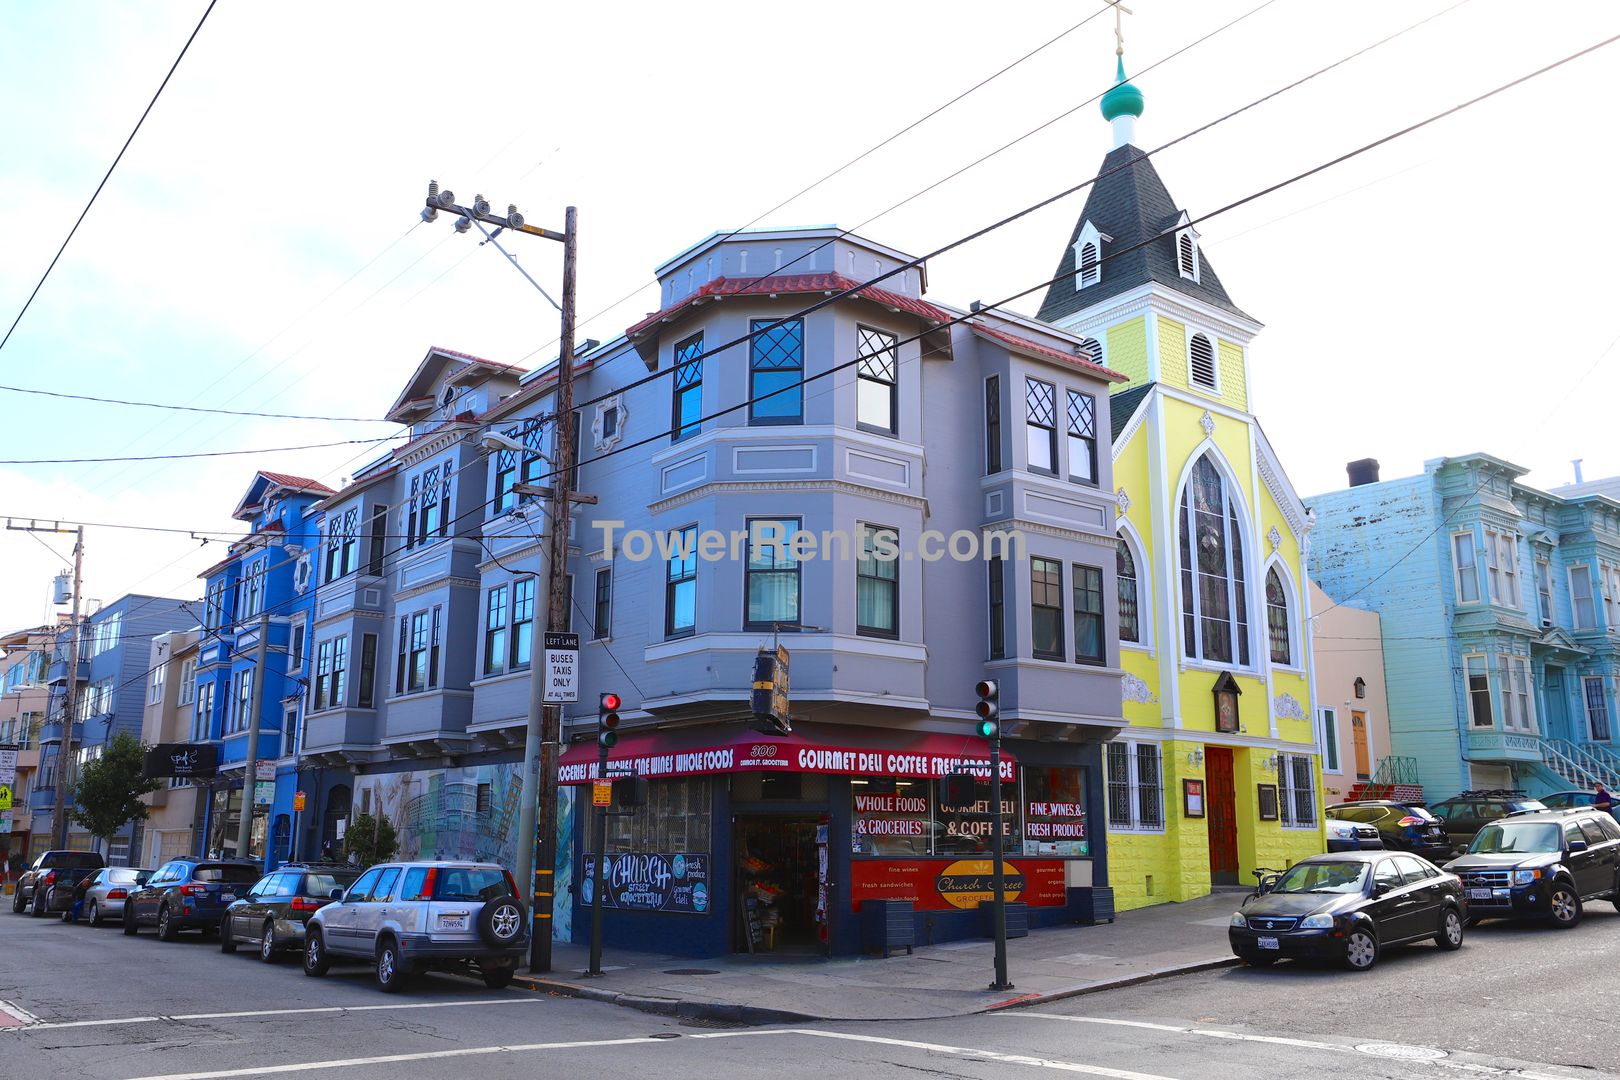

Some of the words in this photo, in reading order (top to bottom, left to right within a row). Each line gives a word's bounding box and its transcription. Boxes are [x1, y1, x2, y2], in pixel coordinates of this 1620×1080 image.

[551, 655, 573, 663] BUSES
[553, 666, 572, 675] TAXIS
[553, 678, 571, 687] ONLY
[750, 745, 778, 757] 300
[558, 764, 586, 782] OCERIES
[651, 755, 674, 774] WINES
[675, 753, 703, 772] WHOLE
[704, 748, 734, 770] FOODS
[798, 749, 857, 769] GOURMET
[859, 753, 883, 771] DELI
[887, 755, 928, 774] COFFEE
[963, 759, 1013, 779] PRODCE
[855, 795, 893, 812] WHOLE
[896, 797, 926, 812] FOODS
[999, 801, 1014, 814] ELI
[1029, 802, 1048, 816] FINE
[1050, 802, 1074, 816] WINES
[1074, 804, 1082, 816] &
[858, 820, 867, 834] &
[869, 820, 922, 835] GROCERIES
[947, 821, 957, 835] &
[960, 821, 1010, 836] COFFE
[1027, 822, 1051, 836] FRESH
[1053, 823, 1084, 837] PRODUCE
[612, 855, 671, 889] CHURCH
[628, 883, 650, 892] STREET
[937, 877, 981, 892] Church
[620, 891, 662, 907] GROCETERIA
[675, 894, 688, 904] deli
